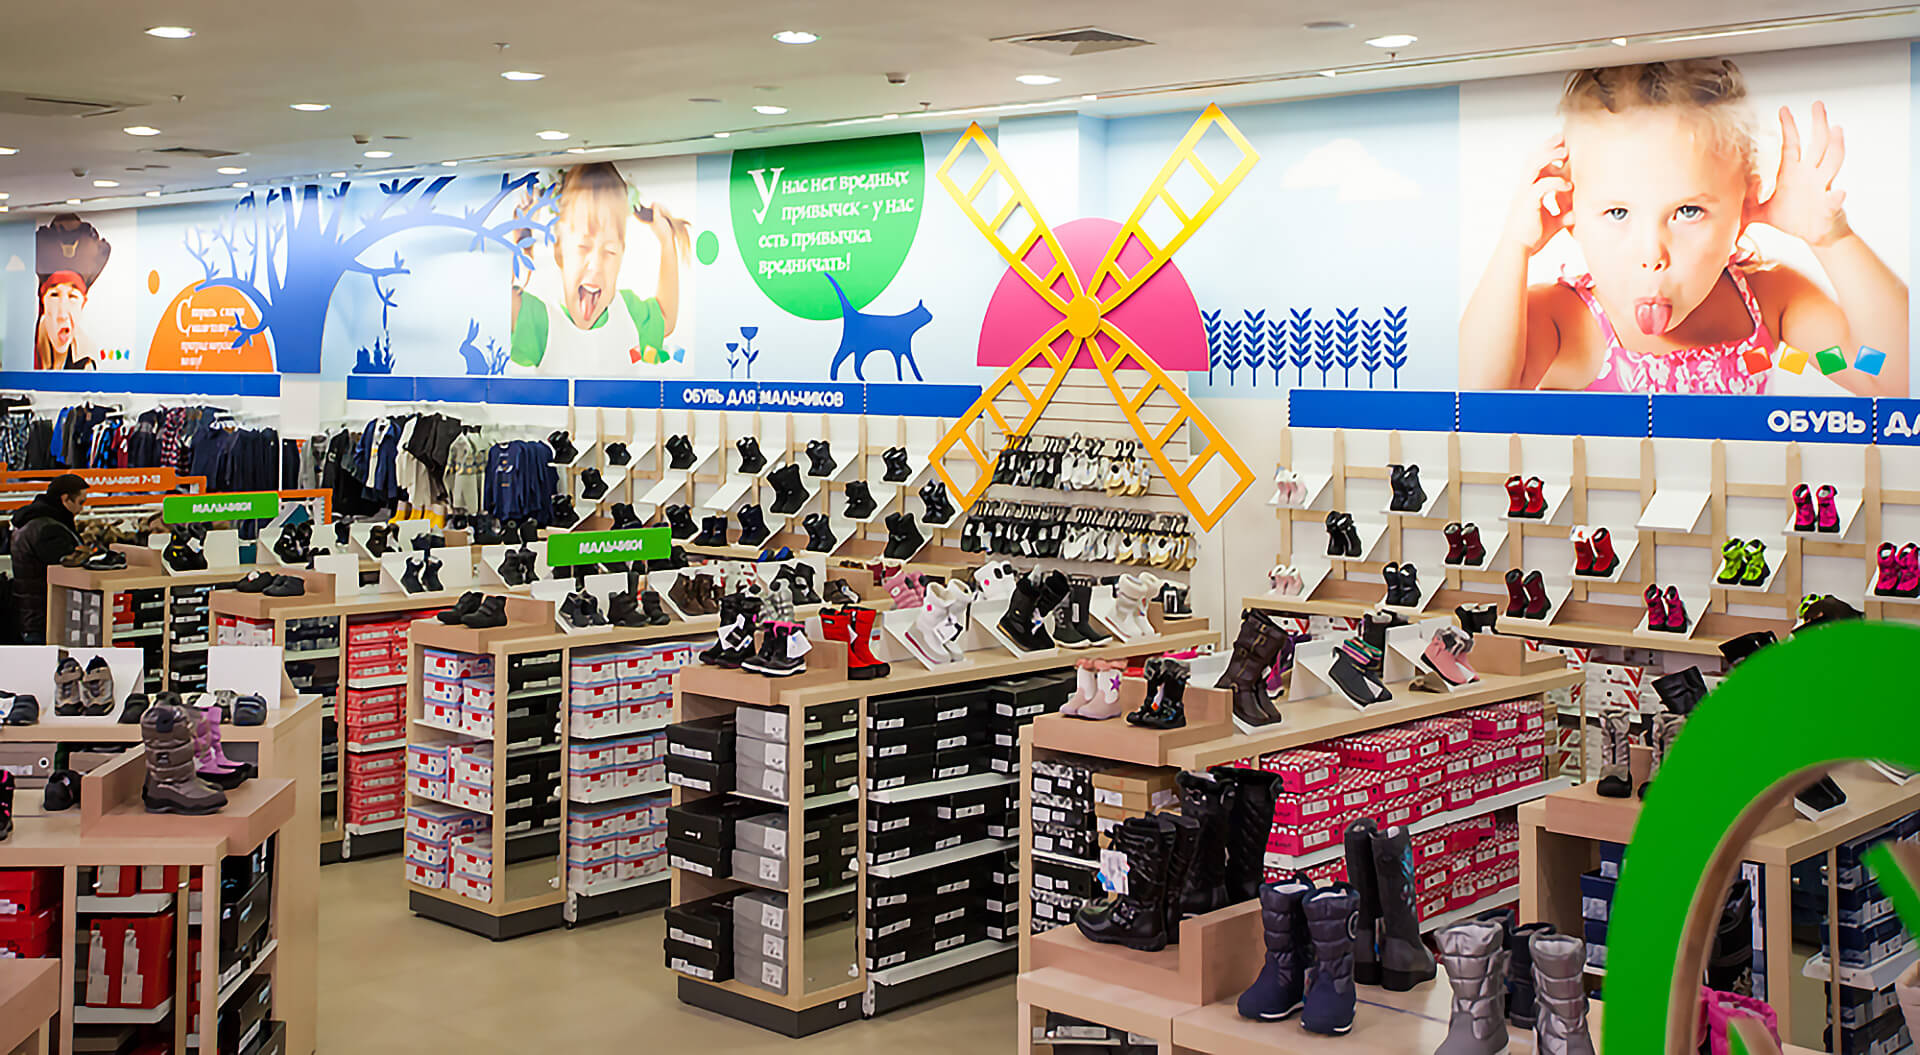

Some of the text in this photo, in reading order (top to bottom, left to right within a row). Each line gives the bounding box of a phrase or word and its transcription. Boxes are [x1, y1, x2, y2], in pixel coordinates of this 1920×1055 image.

[747, 166, 910, 225] У нас нет вредных
[782, 201, 861, 226] привычек
[872, 199, 883, 221] у
[885, 198, 914, 214] нас
[758, 229, 873, 252] есть привычка
[758, 252, 851, 279] вредничать!
[682, 388, 844, 408] ОБУВЬ ДЛЯ МАЛЬЧИКОВ
[1767, 410, 1867, 434] ОБУВЬ
[192, 501, 252, 514] МАЛЬЧИКИ
[579, 539, 643, 555] МАЛЬЧИКИ
